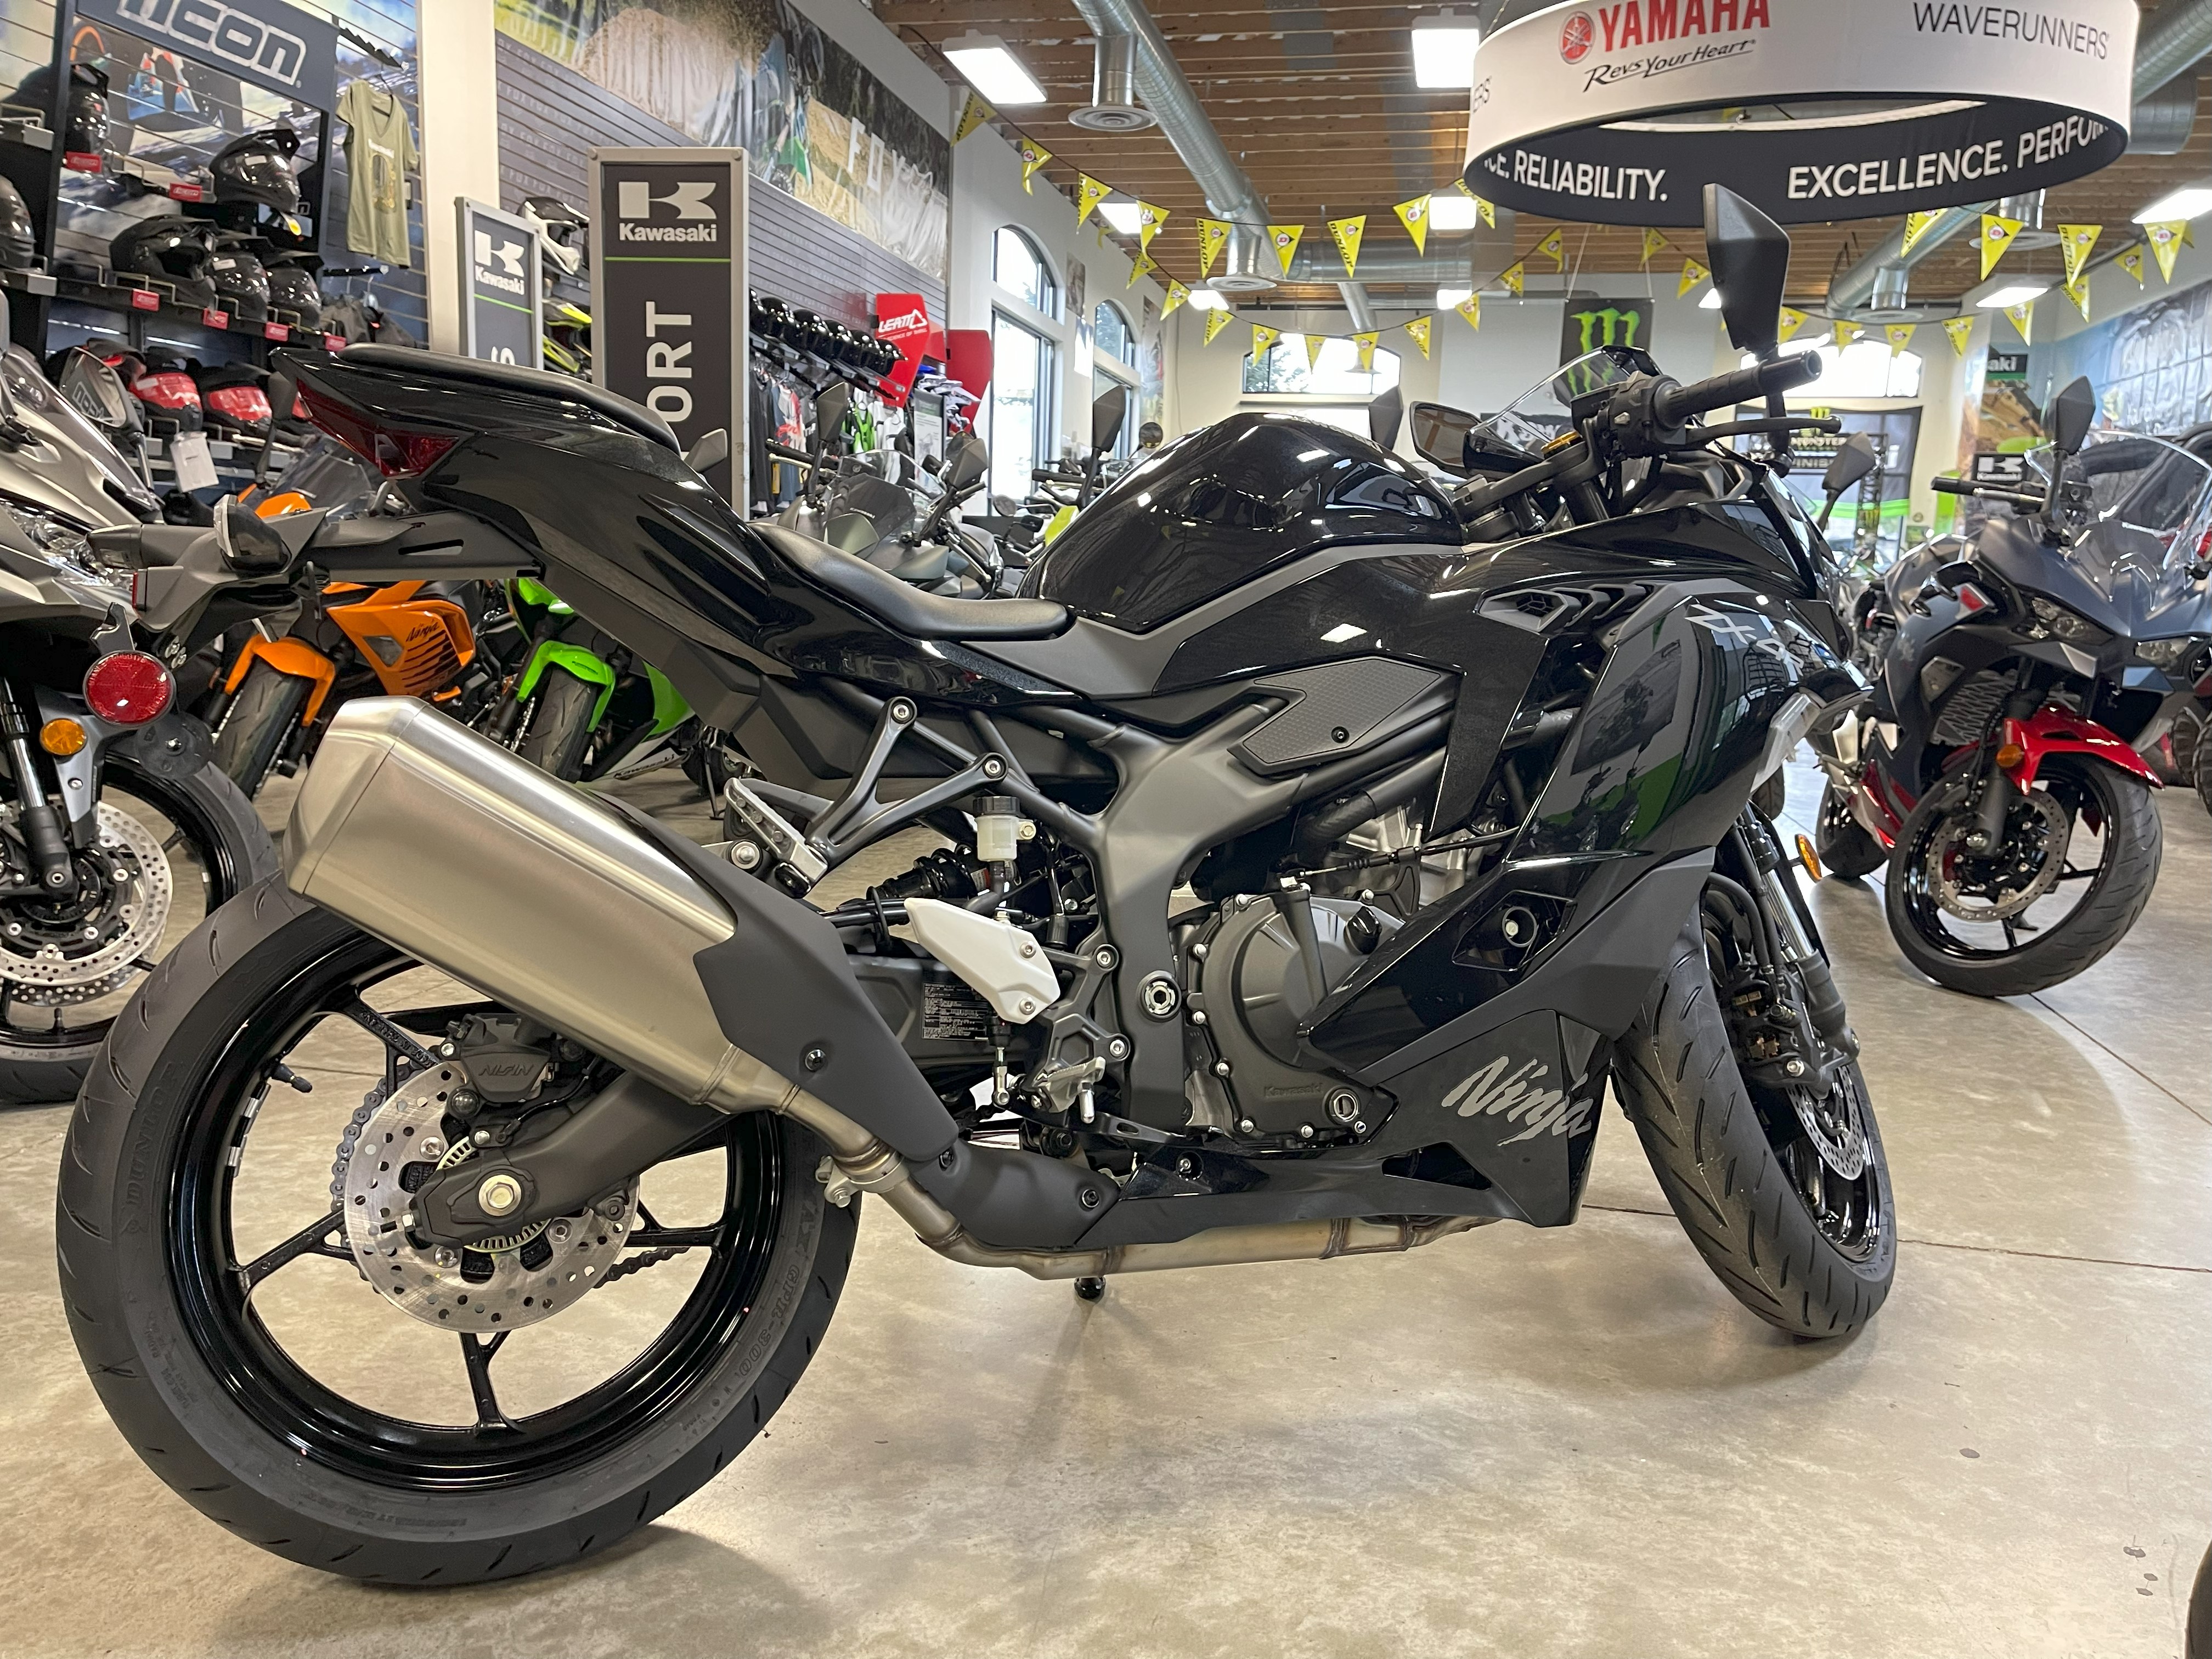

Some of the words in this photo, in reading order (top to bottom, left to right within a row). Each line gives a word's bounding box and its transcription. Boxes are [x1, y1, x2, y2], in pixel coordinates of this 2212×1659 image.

[1599, 0, 1770, 52] YAMAHA
[1913, 2, 2109, 60] WAVERUNNERS
[1583, 59, 1644, 92] Revs
[1642, 53, 1695, 78] Your
[1514, 149, 1668, 202] RELIABILITY.
[1787, 140, 2008, 200] EXCELLENCE.
[619, 223, 717, 242] Kawasaki
[1199, 220, 1209, 269] DUNLOP
[1330, 223, 1354, 268] DUNLOP
[475, 265, 525, 295] Kawasaki
[646, 301, 692, 423] ORT
[1987, 356, 2018, 371] aki
[405, 618, 440, 642] Ninja
[1264, 1083, 1324, 1097] Kawasaki
[1441, 1054, 1593, 1147] Ninja
[740, 1264, 800, 1376] GPR-300
